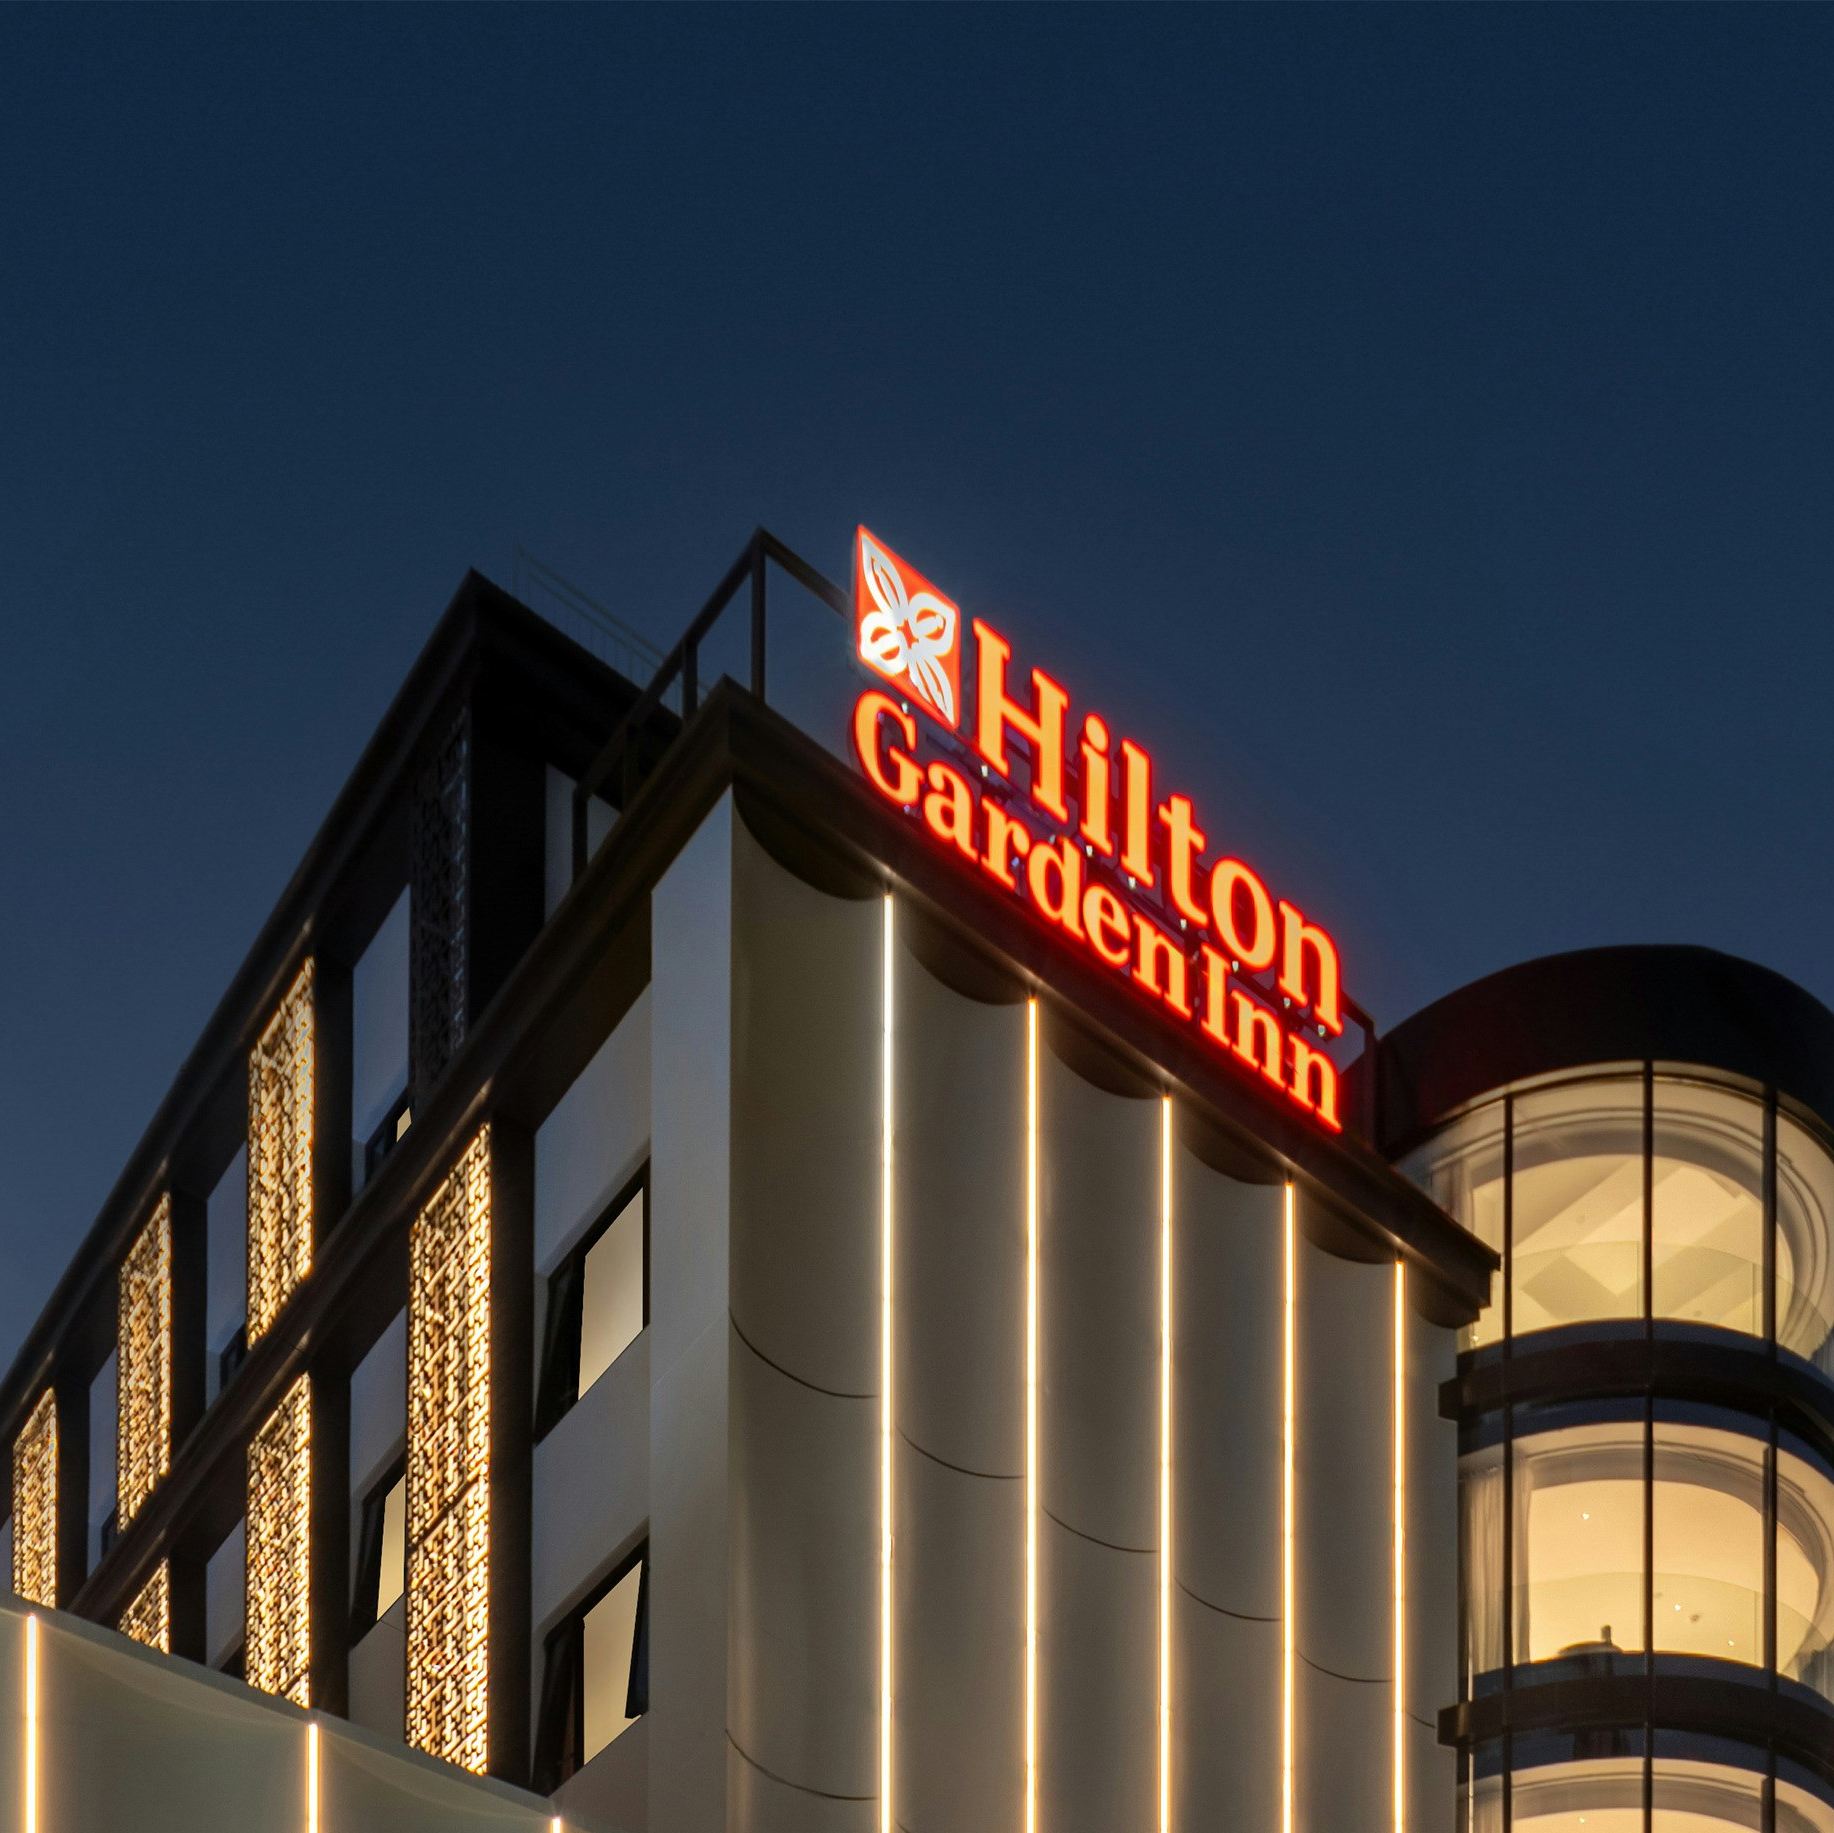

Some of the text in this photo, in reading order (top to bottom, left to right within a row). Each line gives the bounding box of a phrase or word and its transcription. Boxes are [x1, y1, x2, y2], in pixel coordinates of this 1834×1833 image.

[854, 688, 1343, 1134] Garden Inn
[971, 616, 1345, 1037] Hilton
